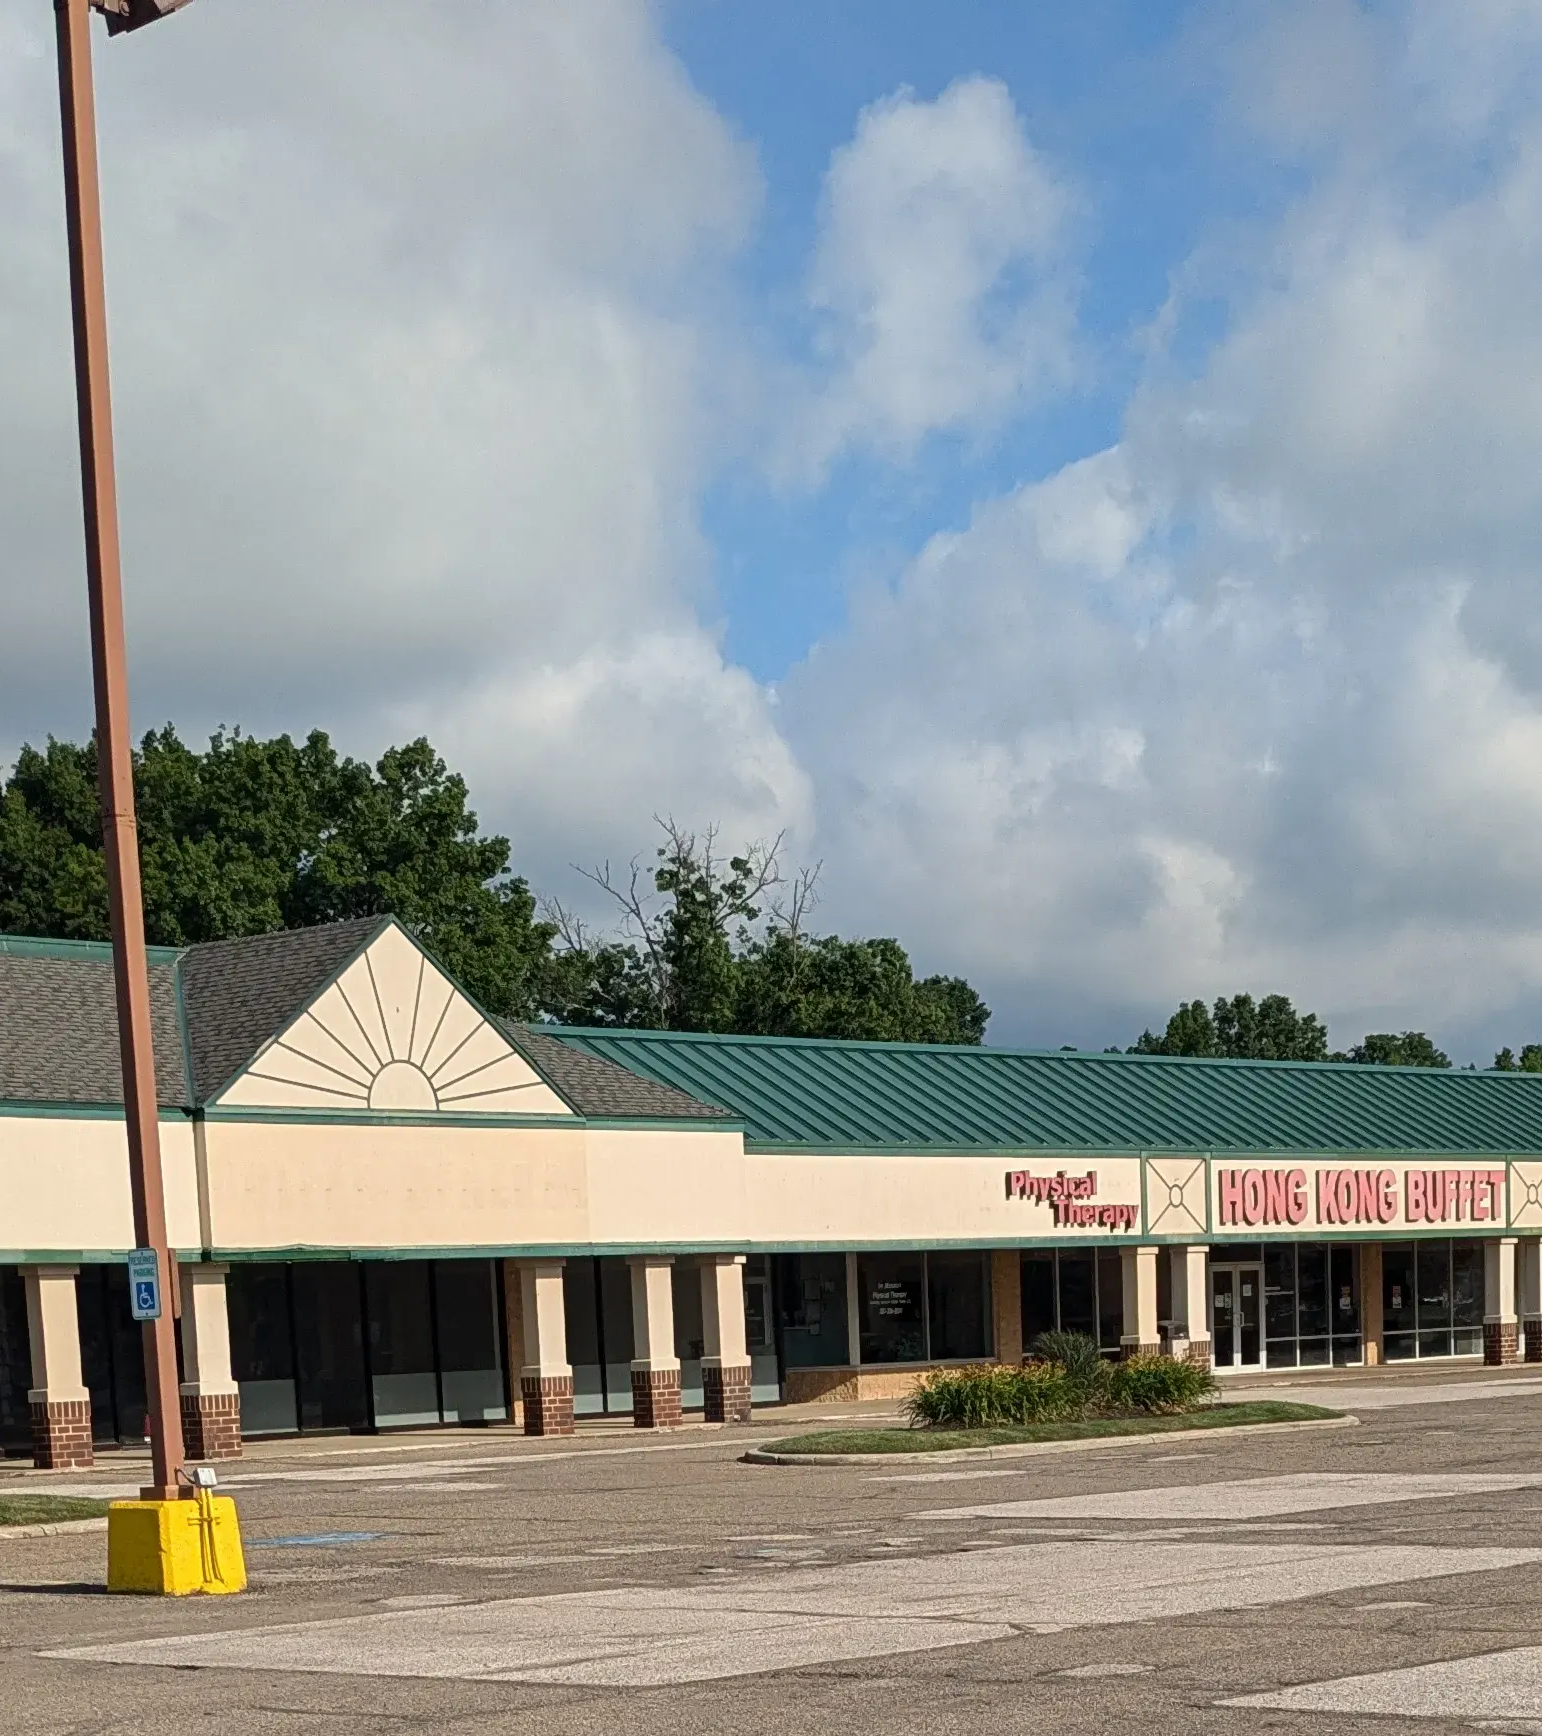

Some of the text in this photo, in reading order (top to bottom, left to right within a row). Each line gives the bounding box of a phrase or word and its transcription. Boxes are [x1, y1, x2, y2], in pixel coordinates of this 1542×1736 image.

[1006, 1170, 1098, 1205] Physical
[1219, 1168, 1506, 1225] HONG KONG BUFFET
[1051, 1198, 1139, 1231] Therapy
